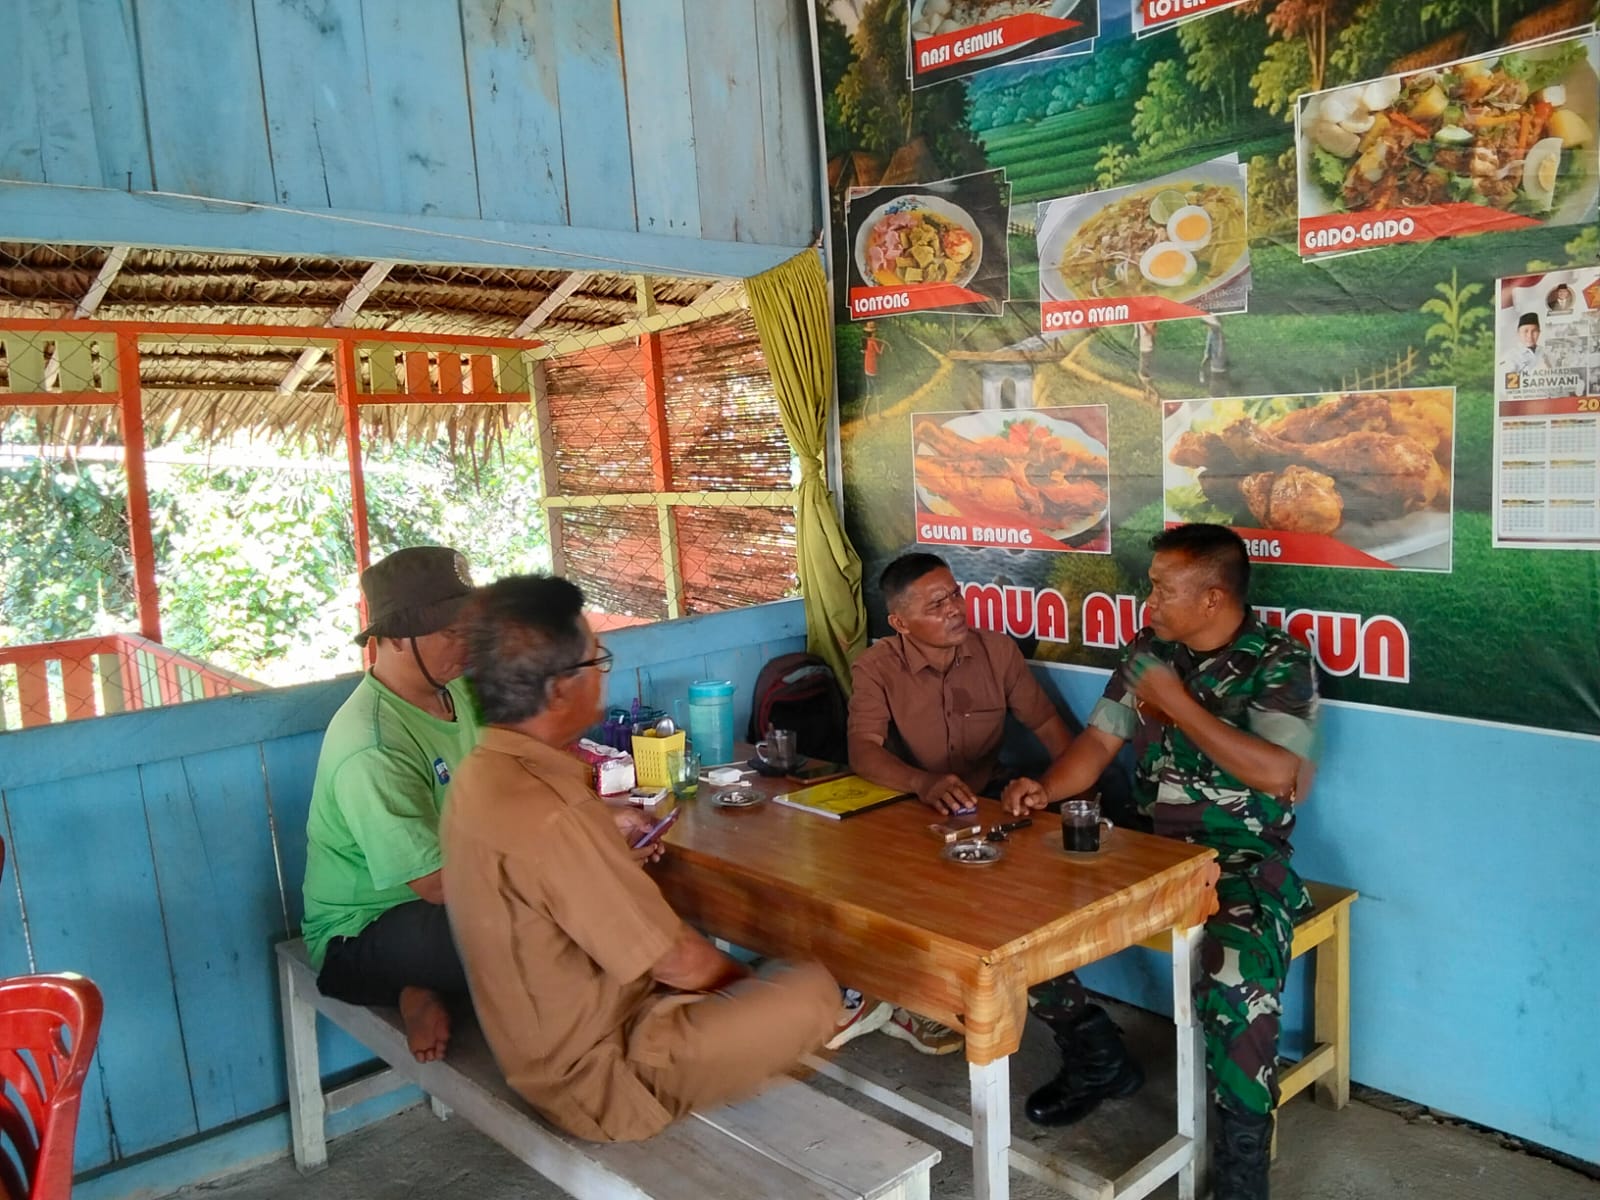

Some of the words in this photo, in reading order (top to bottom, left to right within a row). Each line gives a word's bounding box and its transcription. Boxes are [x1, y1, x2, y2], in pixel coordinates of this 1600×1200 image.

[1149, 0, 1206, 18] LOTE
[920, 44, 950, 67] NASI
[953, 27, 1004, 57] GEMUK
[1304, 217, 1415, 249] GADO-GADO
[854, 292, 910, 313] LONTONG
[1045, 309, 1084, 327] SOTO
[1087, 304, 1129, 323] AYAM
[1522, 375, 1578, 388] SARWANI
[1577, 398, 1600, 412] 20
[920, 524, 967, 541] GULAI
[971, 526, 1033, 545] BAUNG
[1241, 538, 1282, 558] RENG
[956, 581, 1069, 643] MUA
[1082, 592, 1151, 649] AL
